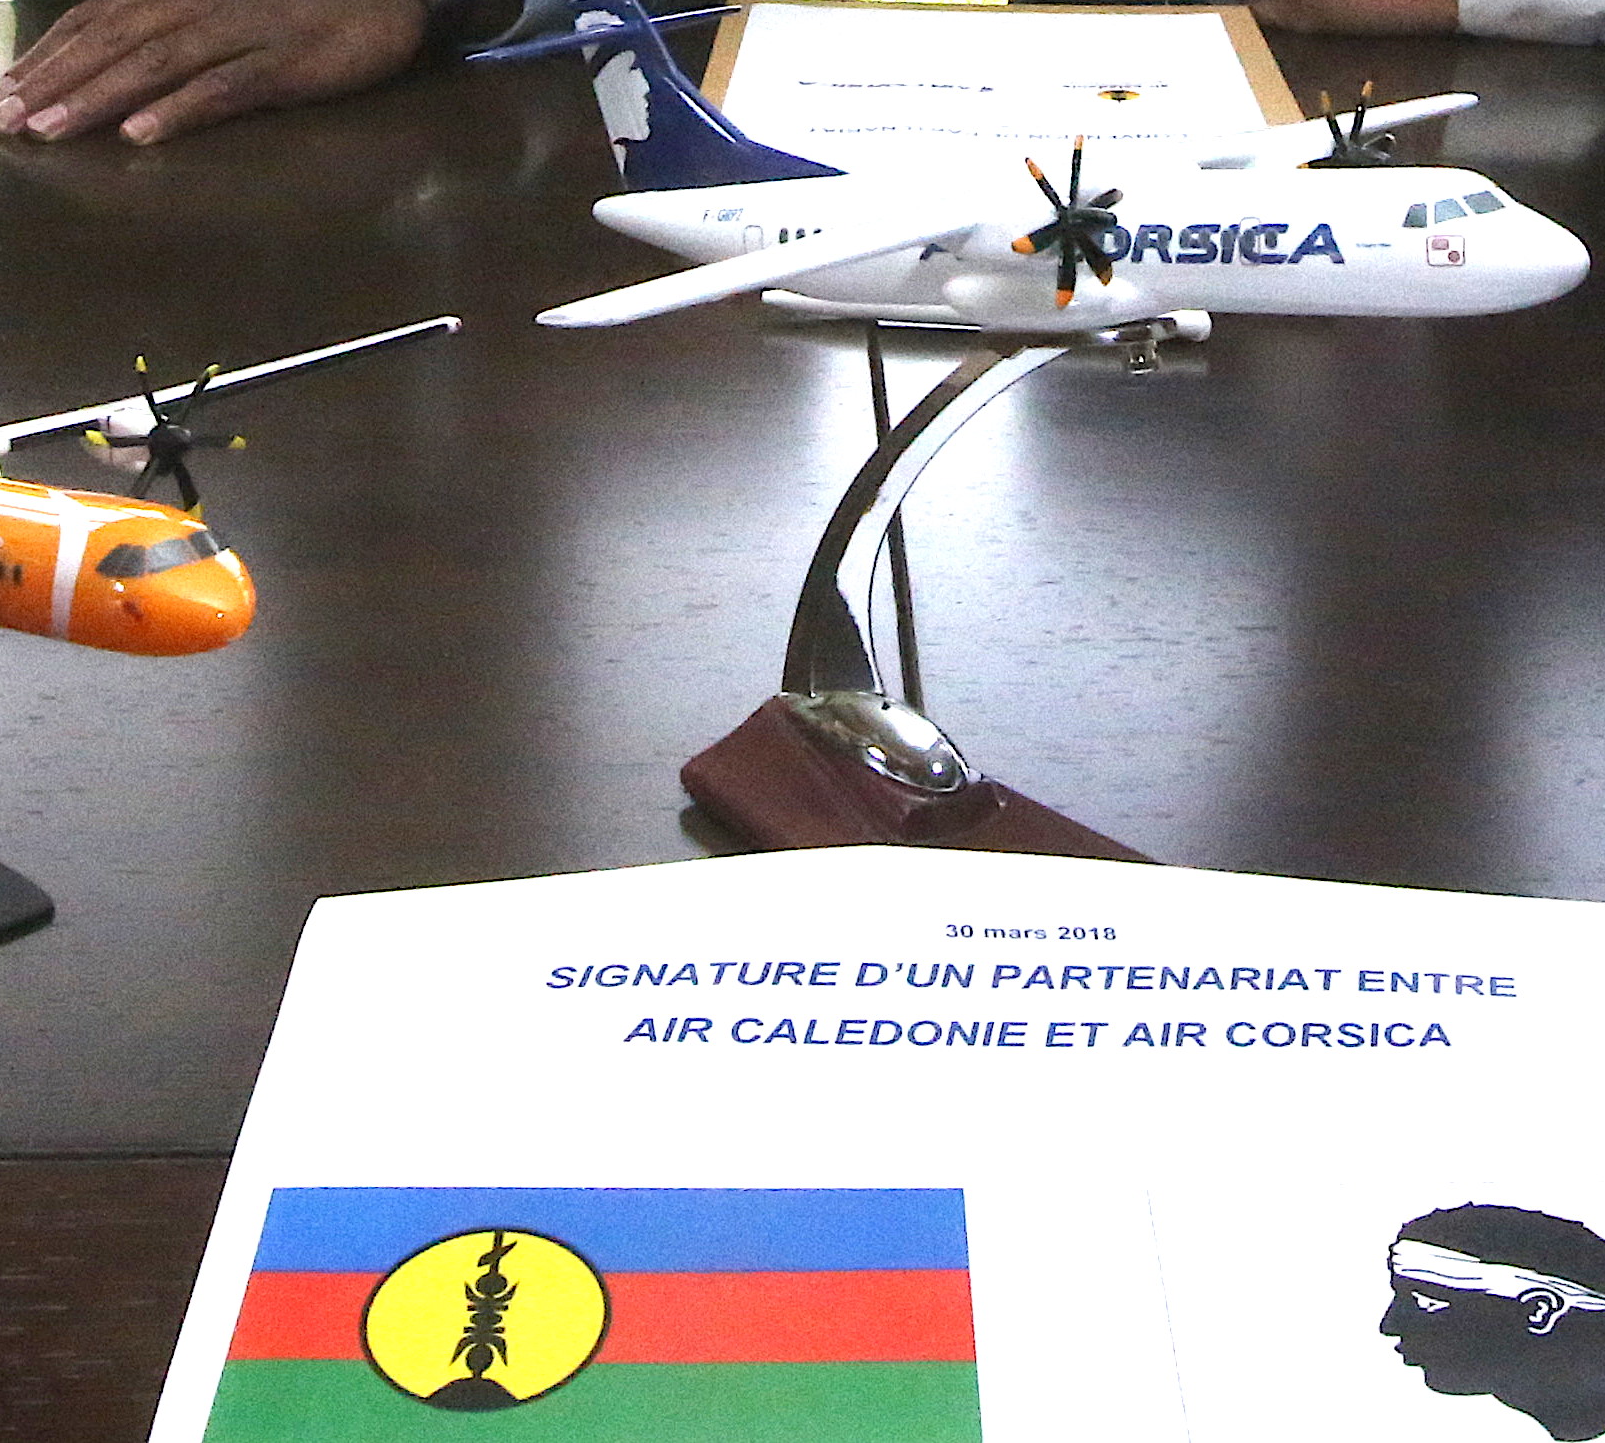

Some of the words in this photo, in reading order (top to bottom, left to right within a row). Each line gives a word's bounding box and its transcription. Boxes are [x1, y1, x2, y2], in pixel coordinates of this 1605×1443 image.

[1086, 223, 1345, 264] ORSICA
[945, 924, 974, 940] 30
[983, 926, 1047, 940] mars
[1057, 925, 1117, 941] 2018
[545, 961, 841, 990] SIGNATURE
[991, 964, 1342, 991] PARTENARIAT
[1358, 969, 1517, 998] ENTRE
[622, 1016, 714, 1043] AIR
[730, 1017, 1029, 1047] CALEDONIE
[1045, 1021, 1110, 1048] ET
[1122, 1021, 1207, 1048] AIR
[1225, 1021, 1452, 1048] CORSICA
